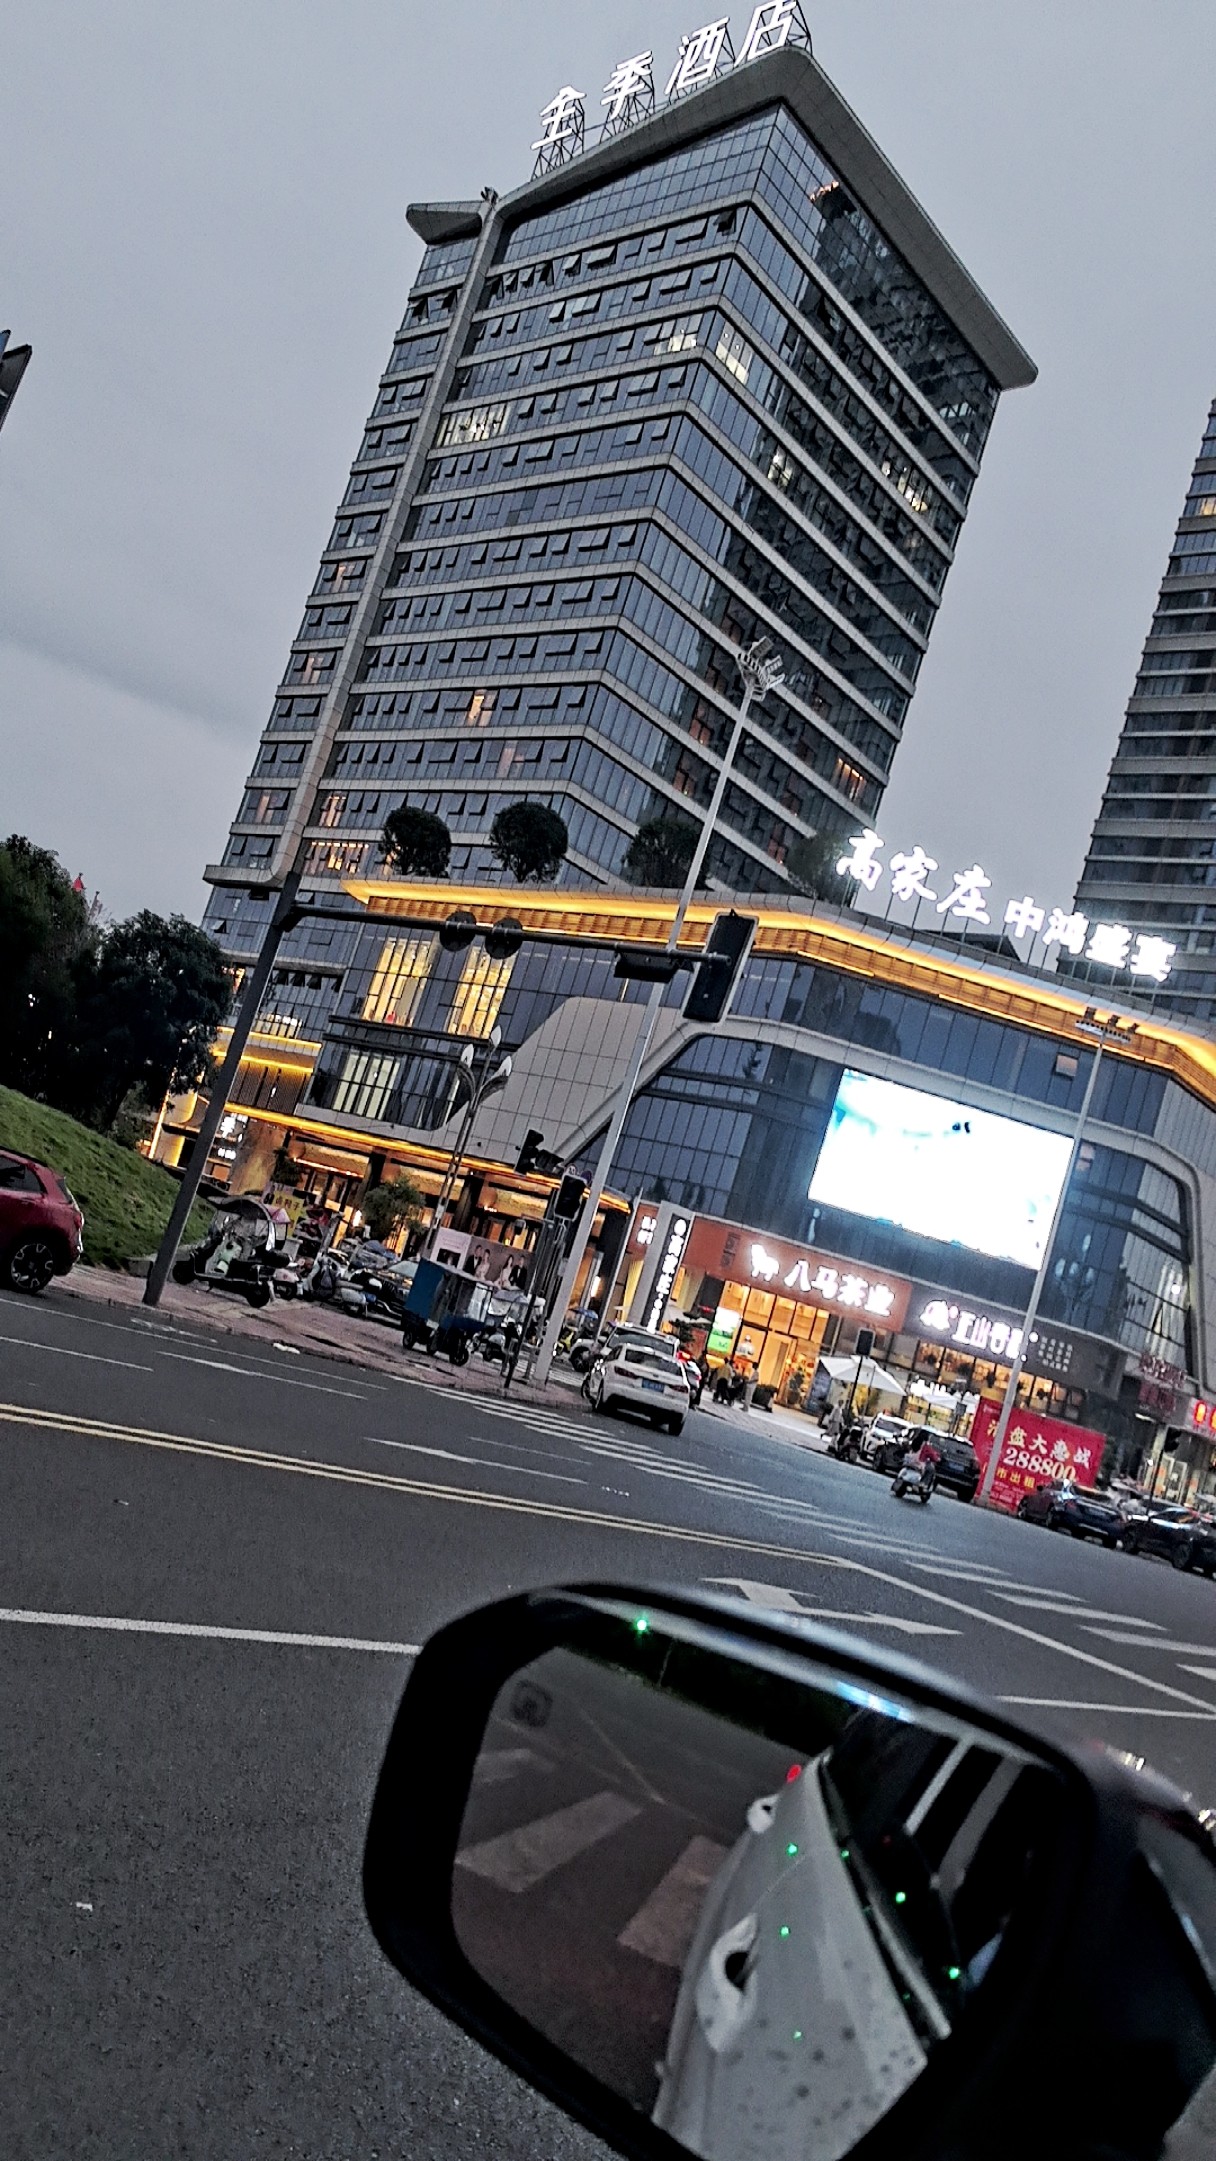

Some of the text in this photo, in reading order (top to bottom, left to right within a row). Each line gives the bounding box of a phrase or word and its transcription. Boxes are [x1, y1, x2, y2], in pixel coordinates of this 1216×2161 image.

[530, 0, 797, 149] 全季酒店
[836, 828, 991, 925] 高家庄
[784, 1259, 896, 1317] 八马茶业
